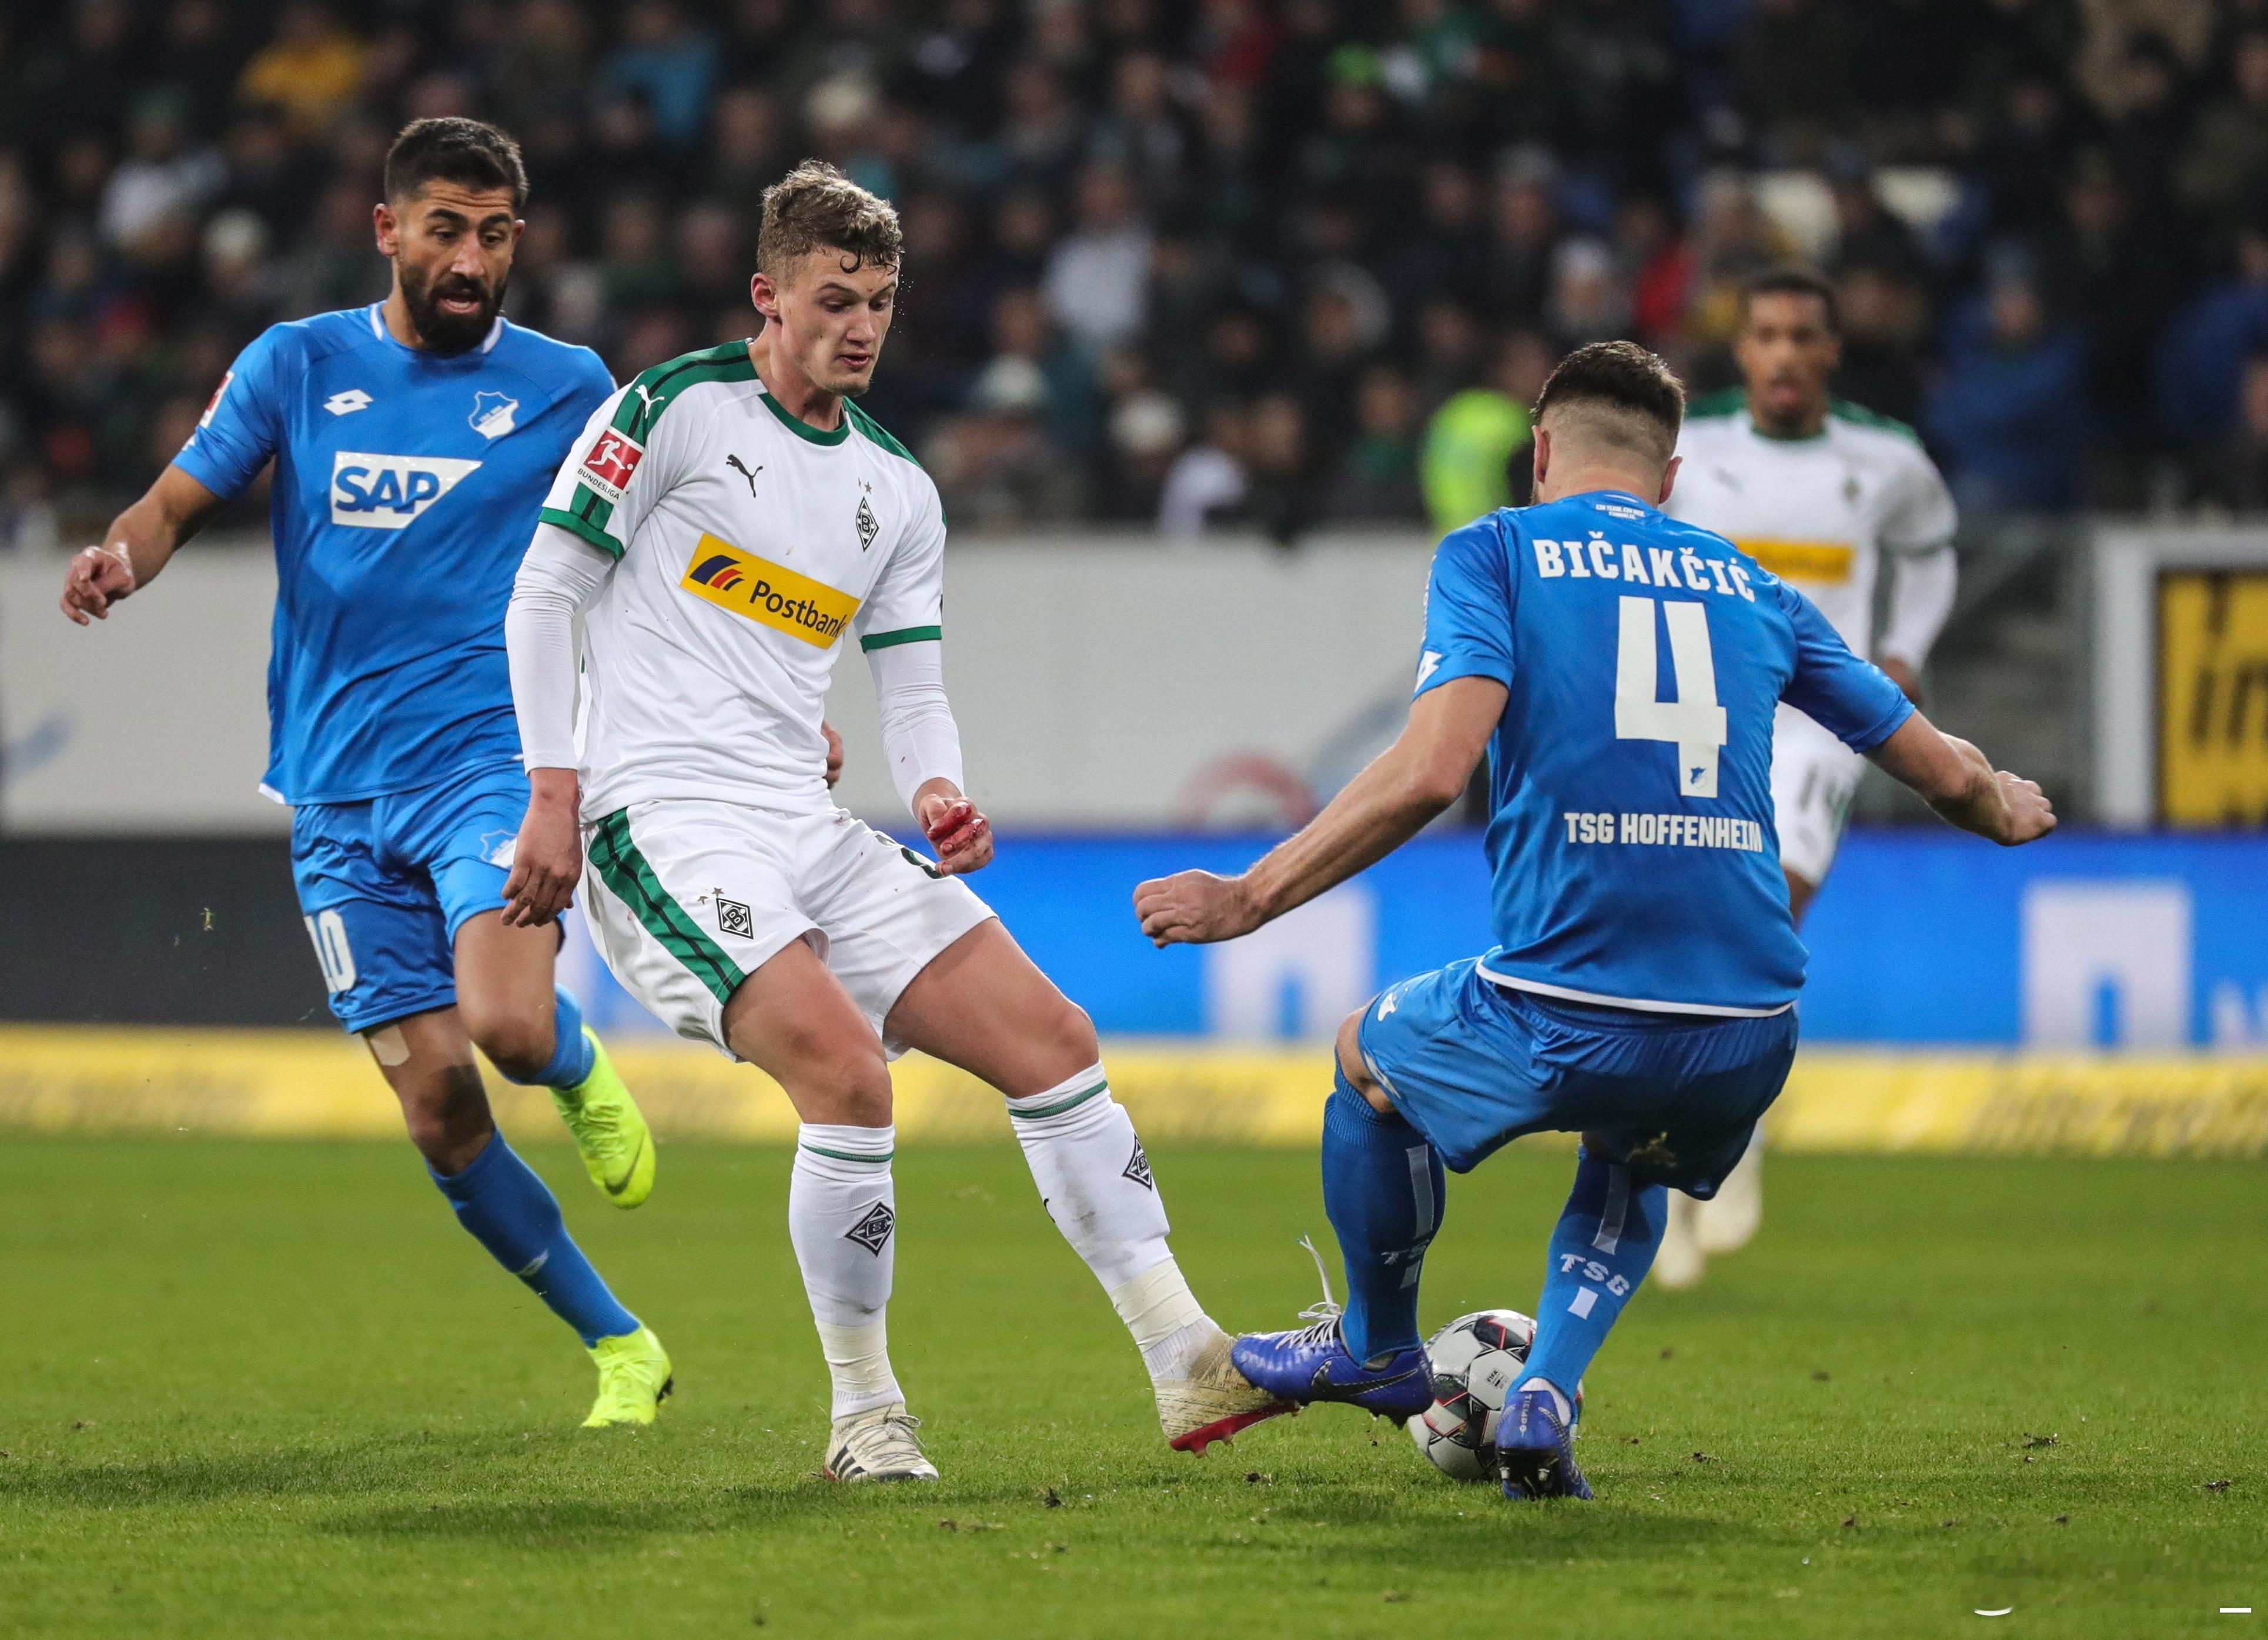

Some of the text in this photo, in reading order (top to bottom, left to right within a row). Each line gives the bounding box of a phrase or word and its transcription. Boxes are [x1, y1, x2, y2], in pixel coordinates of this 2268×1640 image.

[335, 466, 439, 514] SAP
[577, 468, 620, 500] BUNDESLIGA
[749, 580, 847, 638] Postbank
[1614, 595, 1727, 798] 4
[1564, 812, 1762, 852] TSG HOFFENHEIM
[303, 909, 357, 993] 10
[1560, 1253, 1630, 1297] TSG
[1487, 1370, 1498, 1383] FIFA
